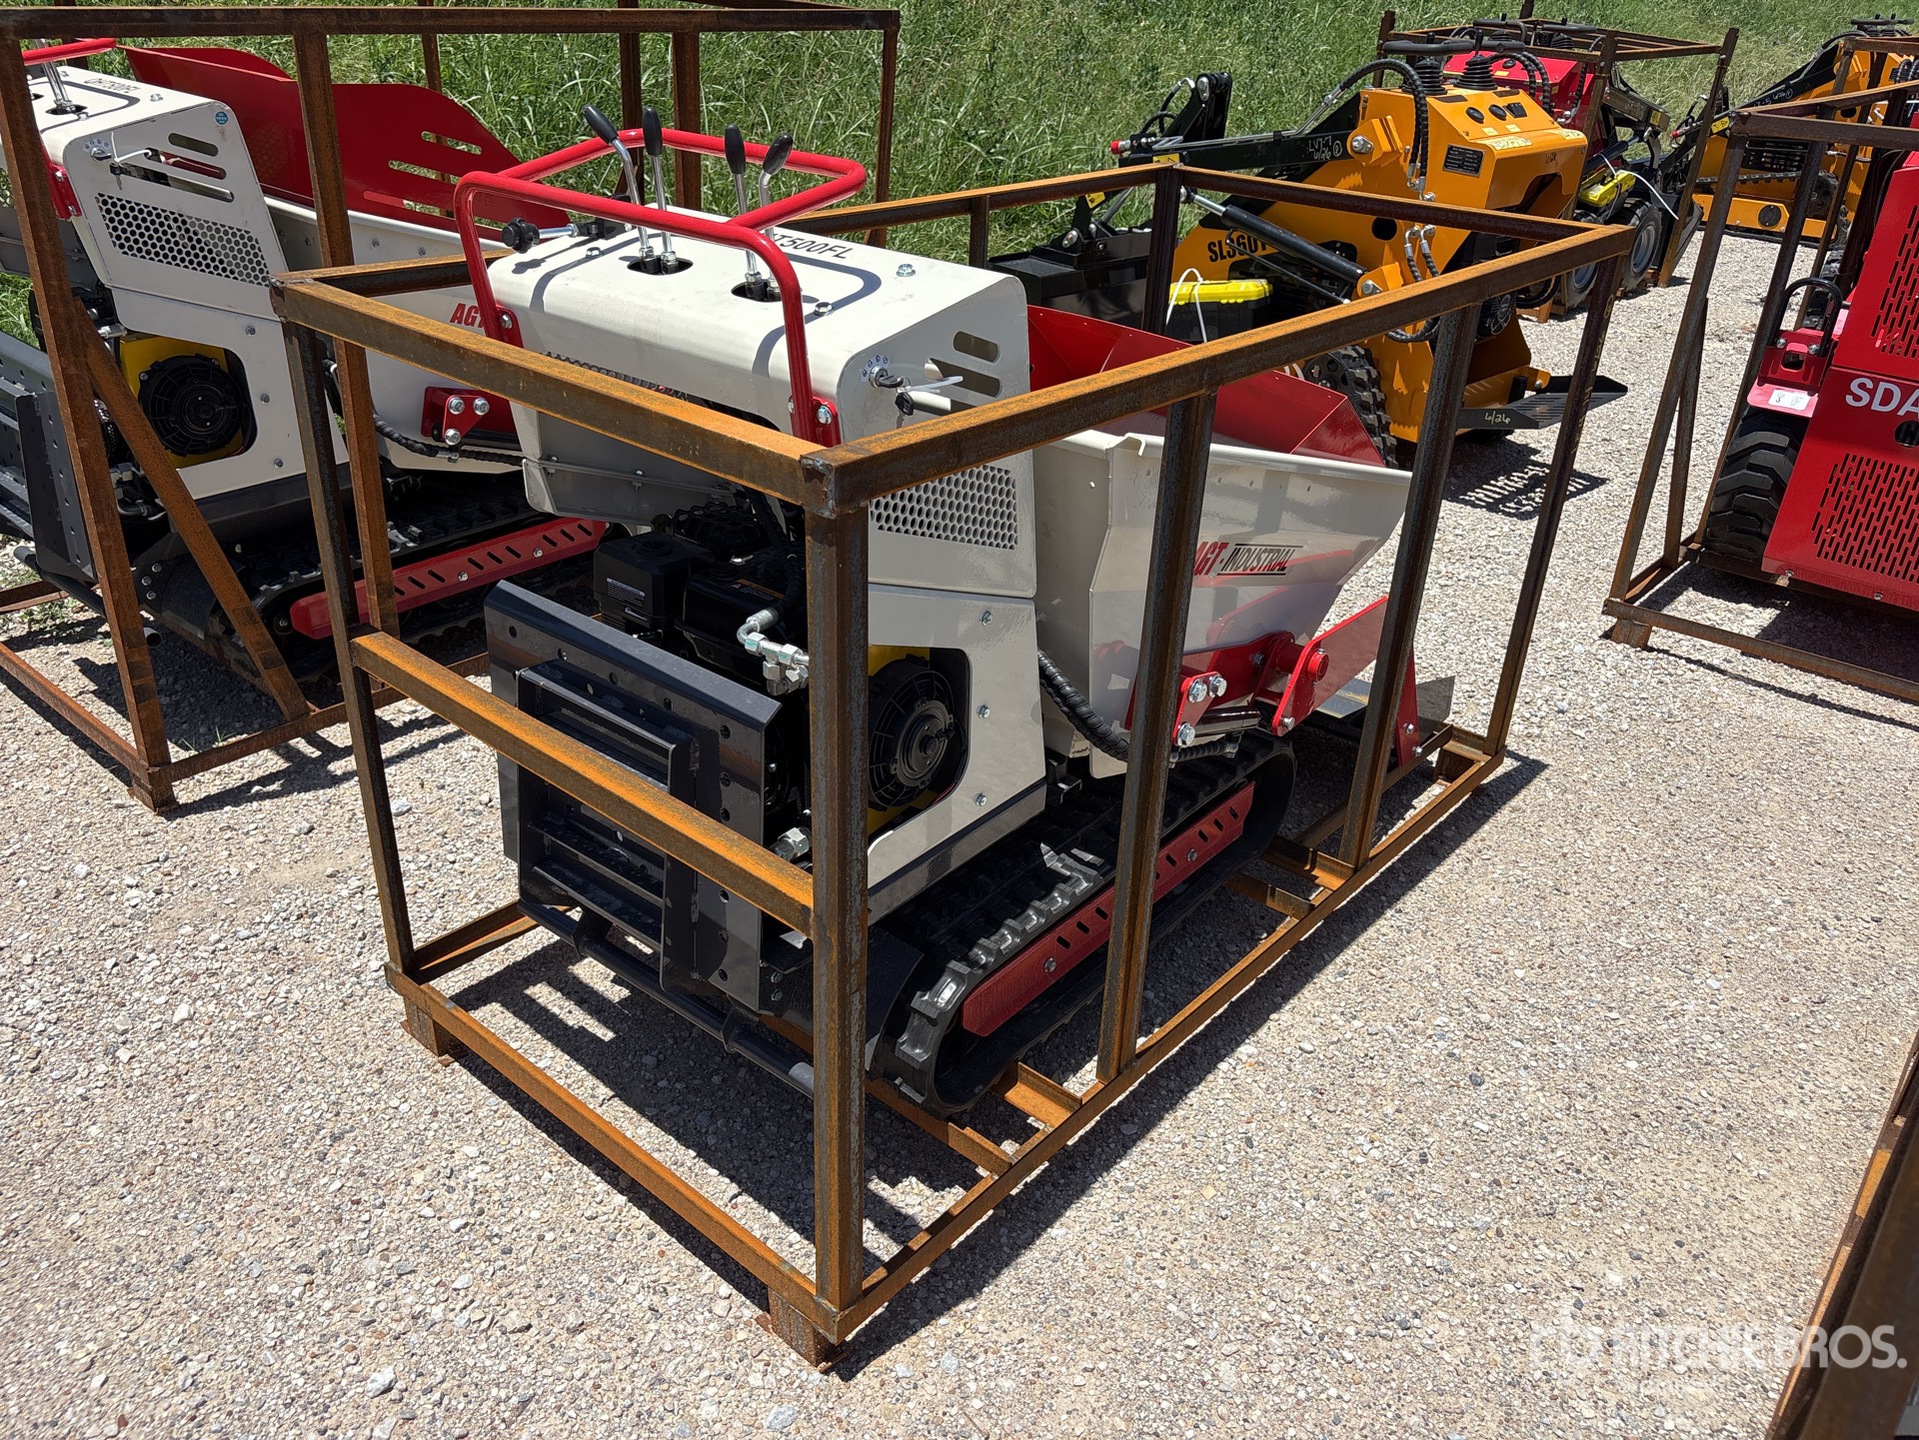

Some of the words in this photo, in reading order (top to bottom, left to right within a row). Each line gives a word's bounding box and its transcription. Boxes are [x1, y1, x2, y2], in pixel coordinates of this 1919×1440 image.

[773, 232, 853, 259] T500FL
[449, 303, 485, 328] AG
[1220, 546, 1296, 572] INDUSTRIAL
